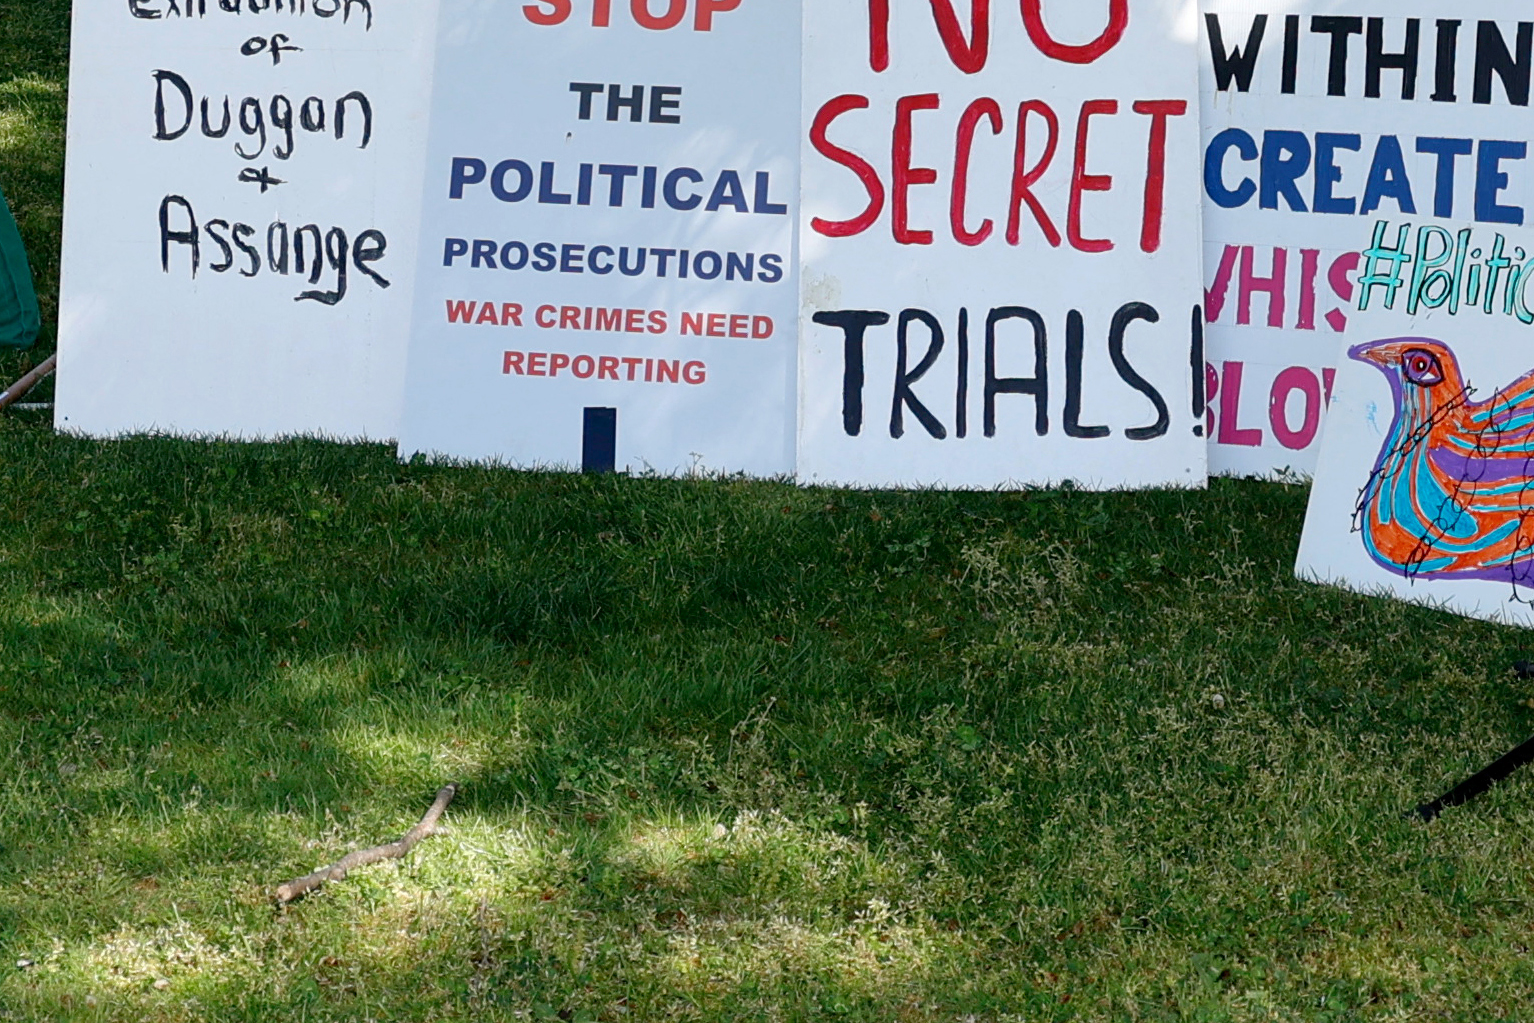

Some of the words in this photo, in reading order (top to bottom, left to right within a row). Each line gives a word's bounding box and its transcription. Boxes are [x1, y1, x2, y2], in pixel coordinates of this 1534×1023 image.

[240, 32, 304, 66] of
[1203, 12, 1534, 106] WITHIN
[150, 69, 373, 161] Duggan
[568, 81, 683, 125] THE
[448, 156, 789, 215] POLITICAL
[809, 92, 1188, 254] SECRET
[1203, 127, 1528, 225] CREATE
[157, 194, 391, 306] Assange
[442, 237, 784, 284] PROSECUTIONS
[445, 299, 524, 327] WAR
[534, 304, 668, 335] CRIMES
[679, 312, 775, 340] NEED
[501, 350, 707, 386] REPORTING
[812, 301, 1204, 441] TRIALS!
